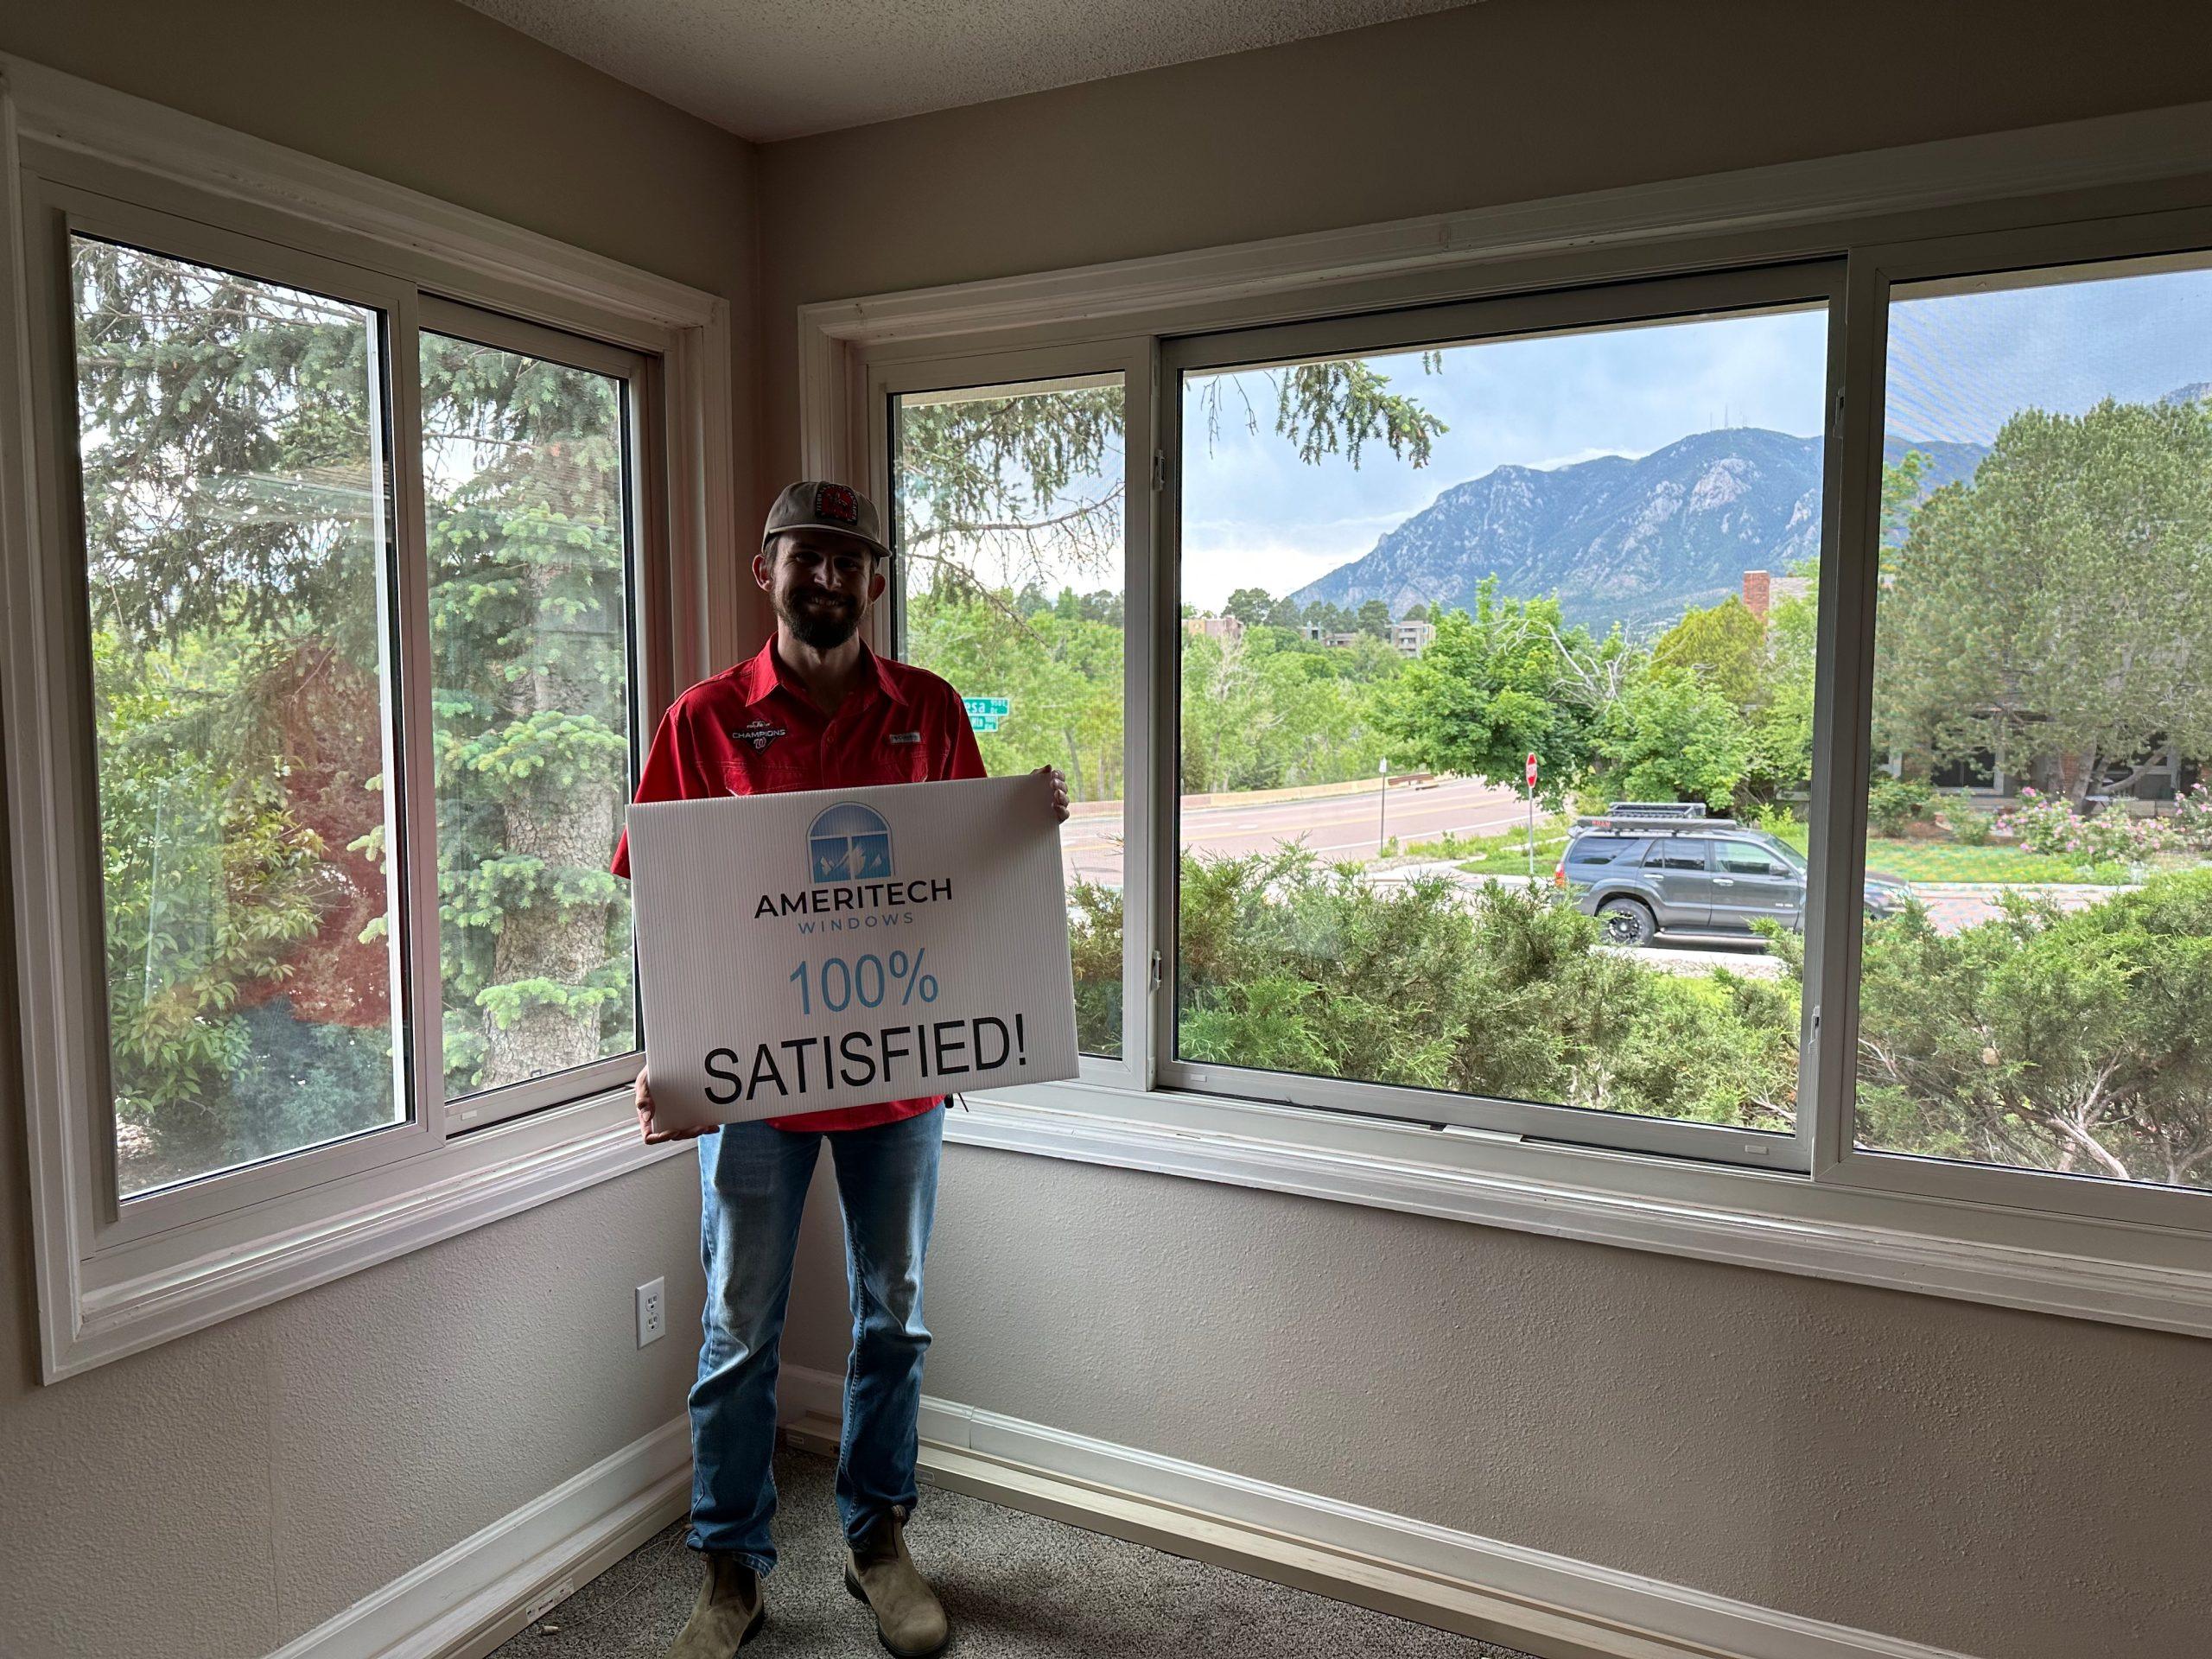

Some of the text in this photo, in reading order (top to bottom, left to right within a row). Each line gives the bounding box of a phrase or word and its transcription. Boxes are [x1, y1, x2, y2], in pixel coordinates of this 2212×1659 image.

[965, 702, 985, 713] esa
[732, 728, 786, 739] CHAMPIONS
[754, 878, 952, 918] AMERITECH
[798, 912, 914, 934] WINDOWS
[790, 948, 938, 1014] 100%
[704, 1014, 1027, 1104] SATISFIED!
